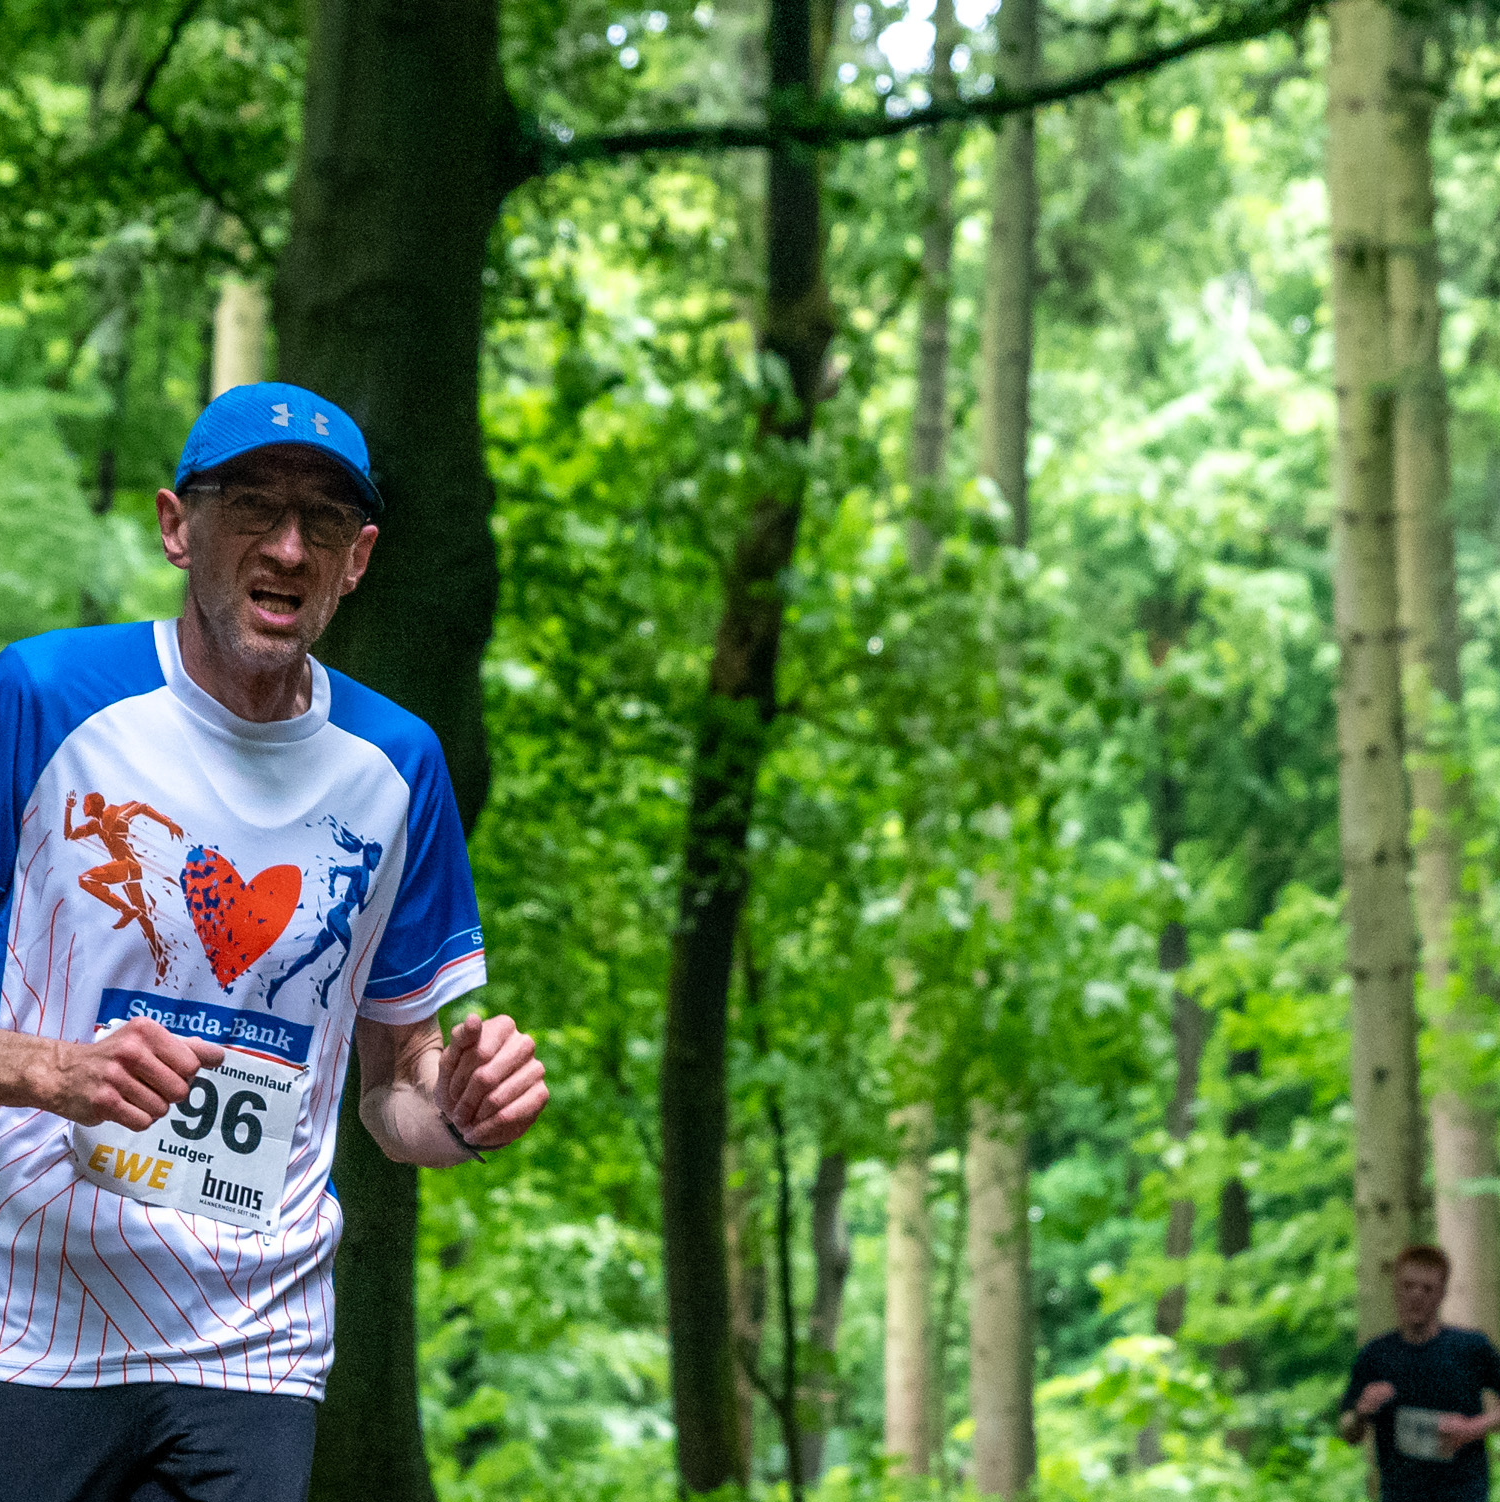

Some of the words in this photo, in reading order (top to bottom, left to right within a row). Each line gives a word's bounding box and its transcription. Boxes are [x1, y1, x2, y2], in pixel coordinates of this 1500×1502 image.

[126, 999, 293, 1052] Sparda-Bank
[203, 1064, 293, 1094] runnenlauf
[88, 1144, 173, 1190] EWE
[158, 1139, 214, 1164] Ludger
[201, 1168, 263, 1211] bruns
[237, 1208, 249, 1217] SEIT
